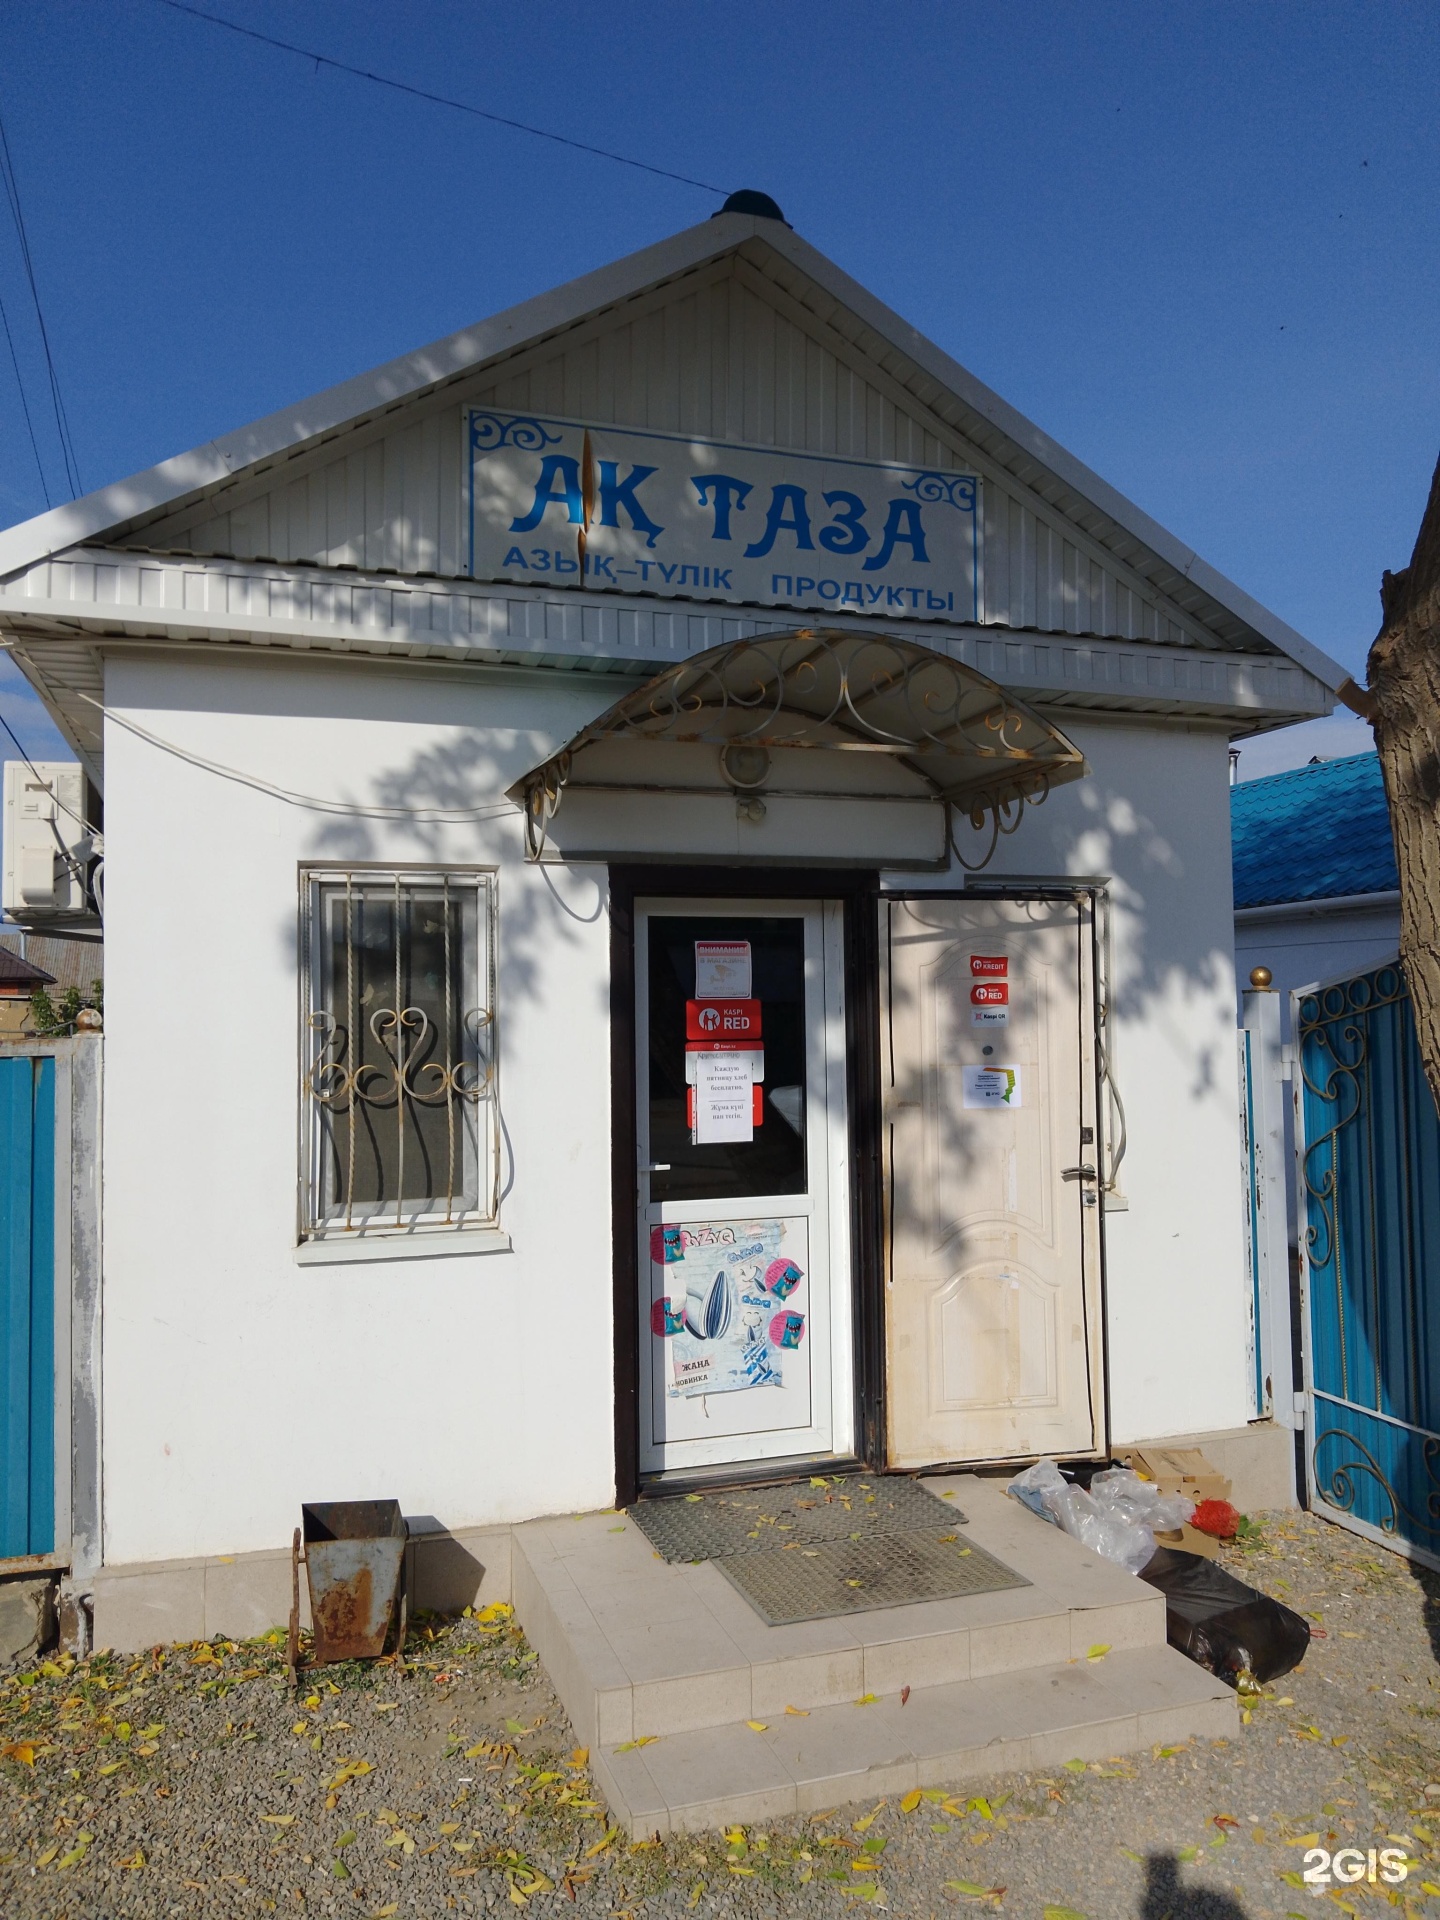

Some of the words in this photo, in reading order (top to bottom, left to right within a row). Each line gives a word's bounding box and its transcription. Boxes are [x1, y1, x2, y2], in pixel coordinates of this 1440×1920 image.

[508, 454, 666, 549] АҚ
[689, 473, 932, 572] ТАЗА
[771, 574, 955, 613] ПРОДУКТЫ
[699, 946, 748, 955] ВНИМАНИЕ!
[723, 1008, 743, 1016] KASPI
[723, 1016, 750, 1030] RED
[714, 1065, 740, 1073] Каждую
[706, 1074, 733, 1082] пятницу
[681, 1359, 711, 1372] ЖАҢА
